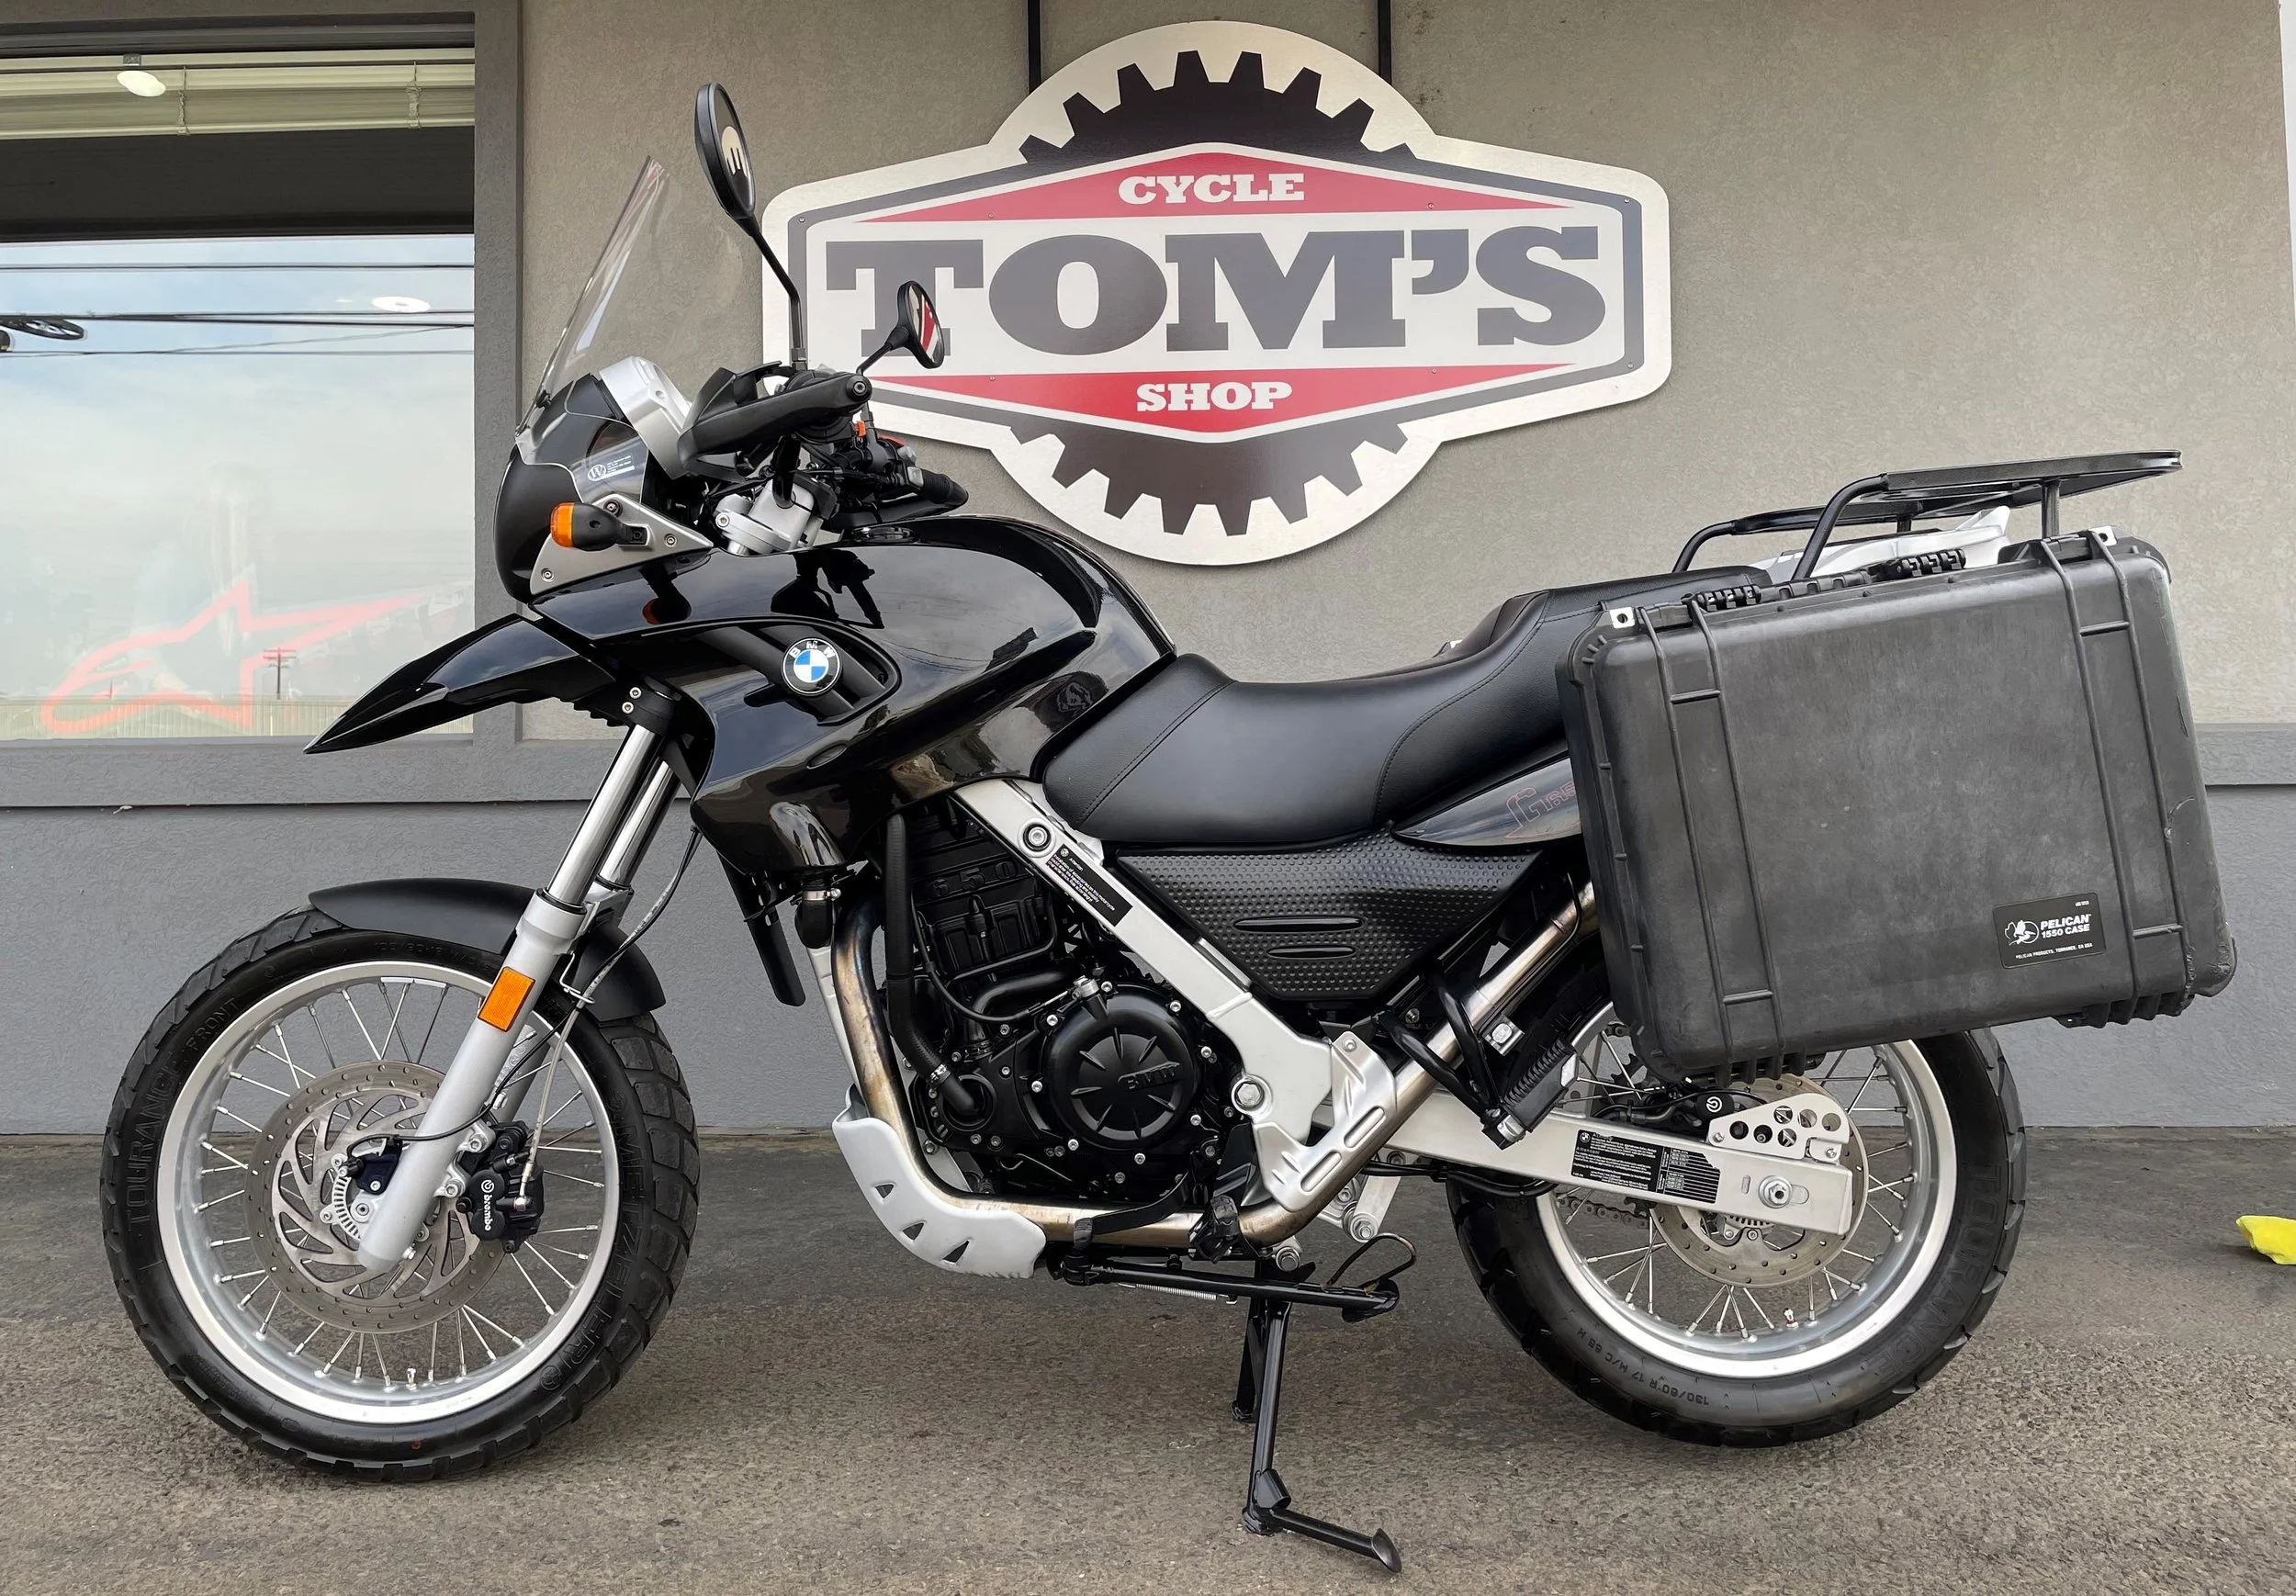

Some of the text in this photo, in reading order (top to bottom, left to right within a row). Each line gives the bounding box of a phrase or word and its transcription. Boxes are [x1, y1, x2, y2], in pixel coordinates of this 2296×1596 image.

[1118, 173, 1305, 206] CYCLE
[826, 226, 1606, 357] TOM'S
[1135, 381, 1293, 413] SHOP
[788, 640, 836, 658] BMW
[933, 861, 1018, 897] 650
[2040, 914, 2090, 930] PELICAN
[2041, 923, 2091, 939] 1550 CASE
[185, 996, 240, 1051] FRONT
[482, 1194, 492, 1231] brembo
[1604, 1354, 1629, 1374] M/C
[1631, 1369, 1645, 1384] 17
[1662, 1384, 1709, 1406] 130/80
